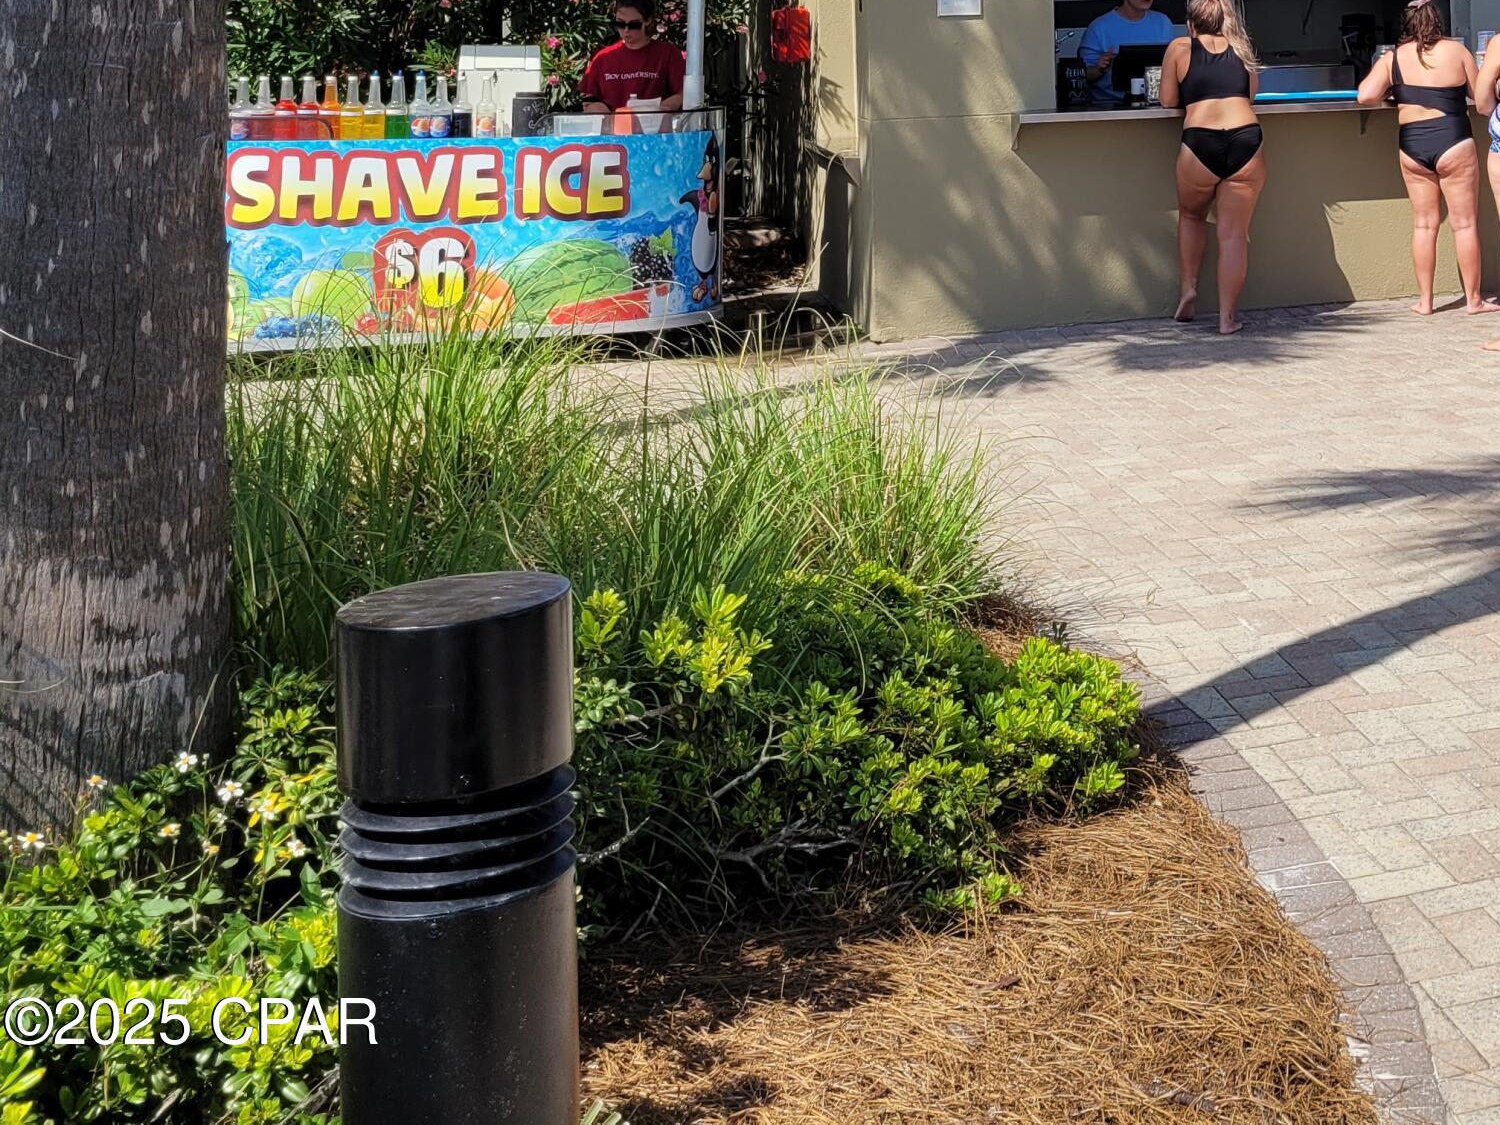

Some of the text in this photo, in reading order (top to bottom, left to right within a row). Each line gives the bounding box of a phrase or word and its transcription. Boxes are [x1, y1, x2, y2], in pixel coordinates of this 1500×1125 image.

[605, 73, 620, 81] TROY
[230, 150, 626, 223] SHAVE ICE
[384, 236, 471, 308] $6
